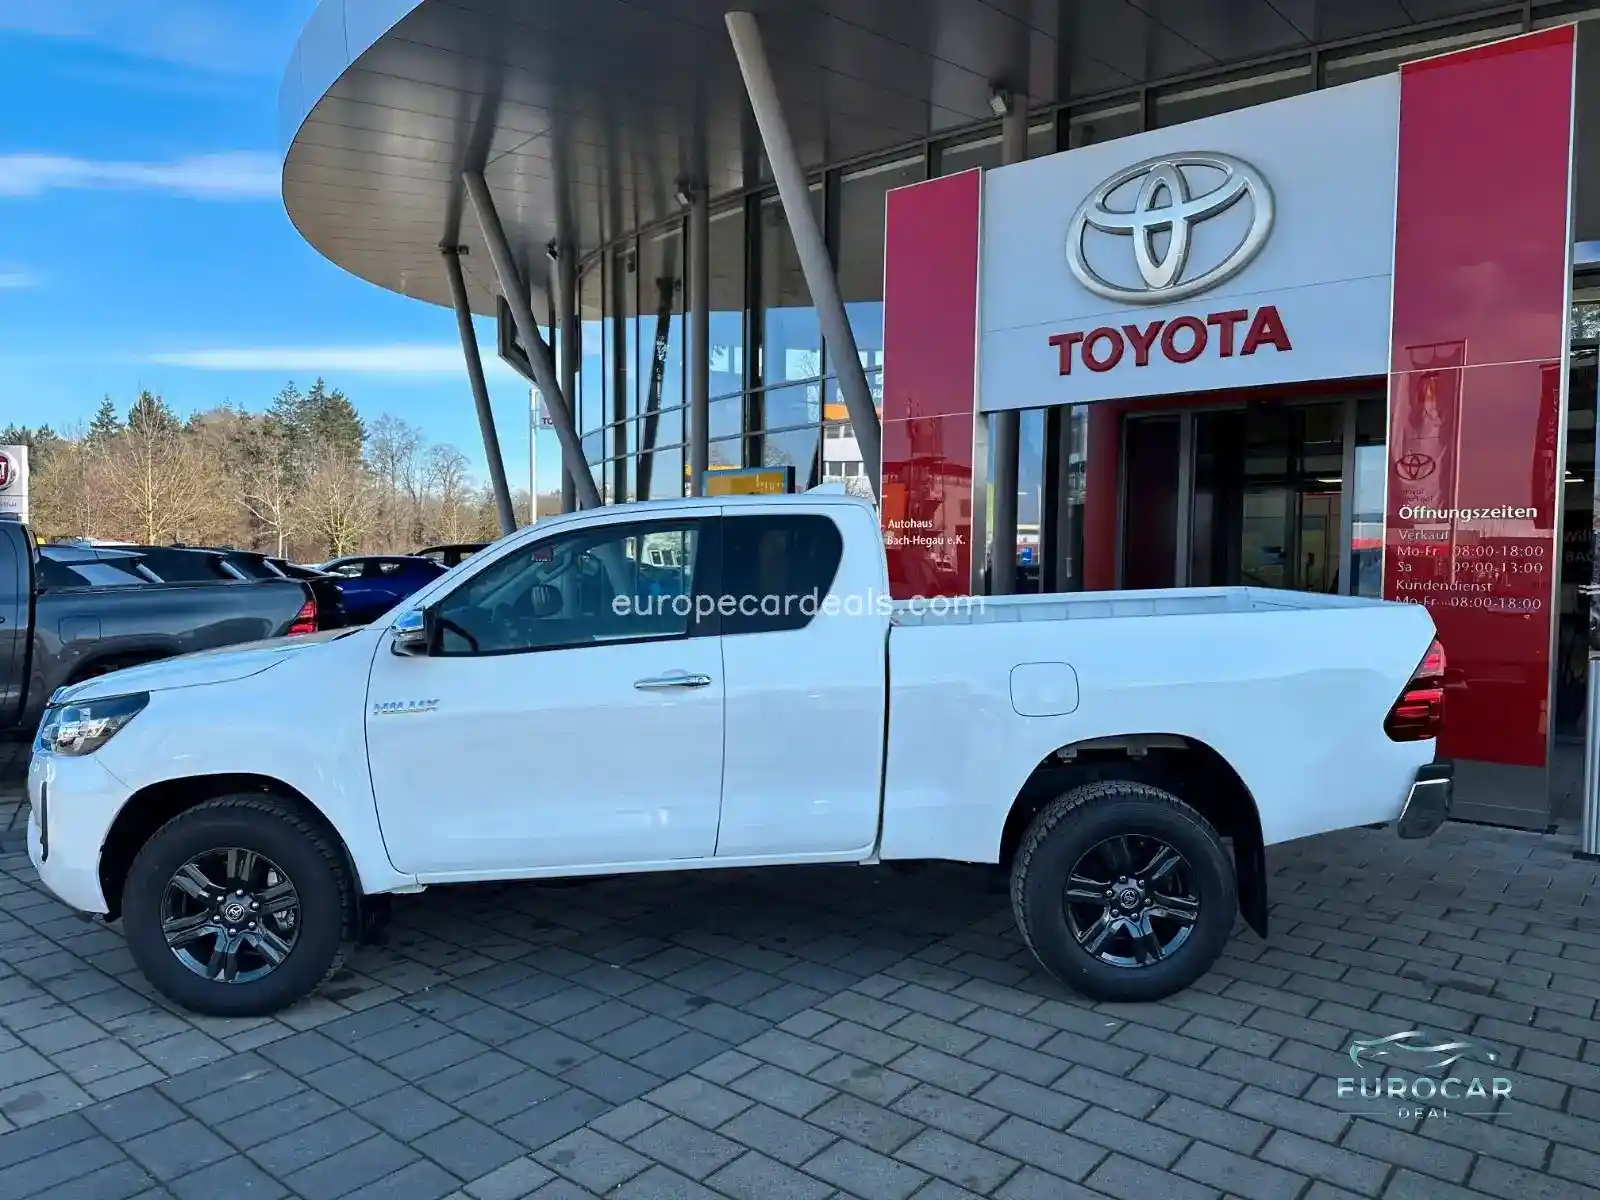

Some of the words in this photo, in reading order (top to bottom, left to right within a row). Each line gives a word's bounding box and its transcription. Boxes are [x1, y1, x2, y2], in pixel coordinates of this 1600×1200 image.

[1048, 305, 1293, 376] TOYOTA
[1399, 504, 1538, 522] Öffnungszeiten
[888, 518, 933, 528] Autohaus
[1399, 530, 1449, 540] Verkauf
[887, 535, 944, 548] Bach-Hegau
[947, 535, 966, 545] e.K.
[1453, 545, 1544, 557] 08:00-18:00
[1397, 561, 1412, 572] Sa
[1396, 580, 1493, 592] Kundendienst
[1450, 596, 1542, 609] 08:00-18:00
